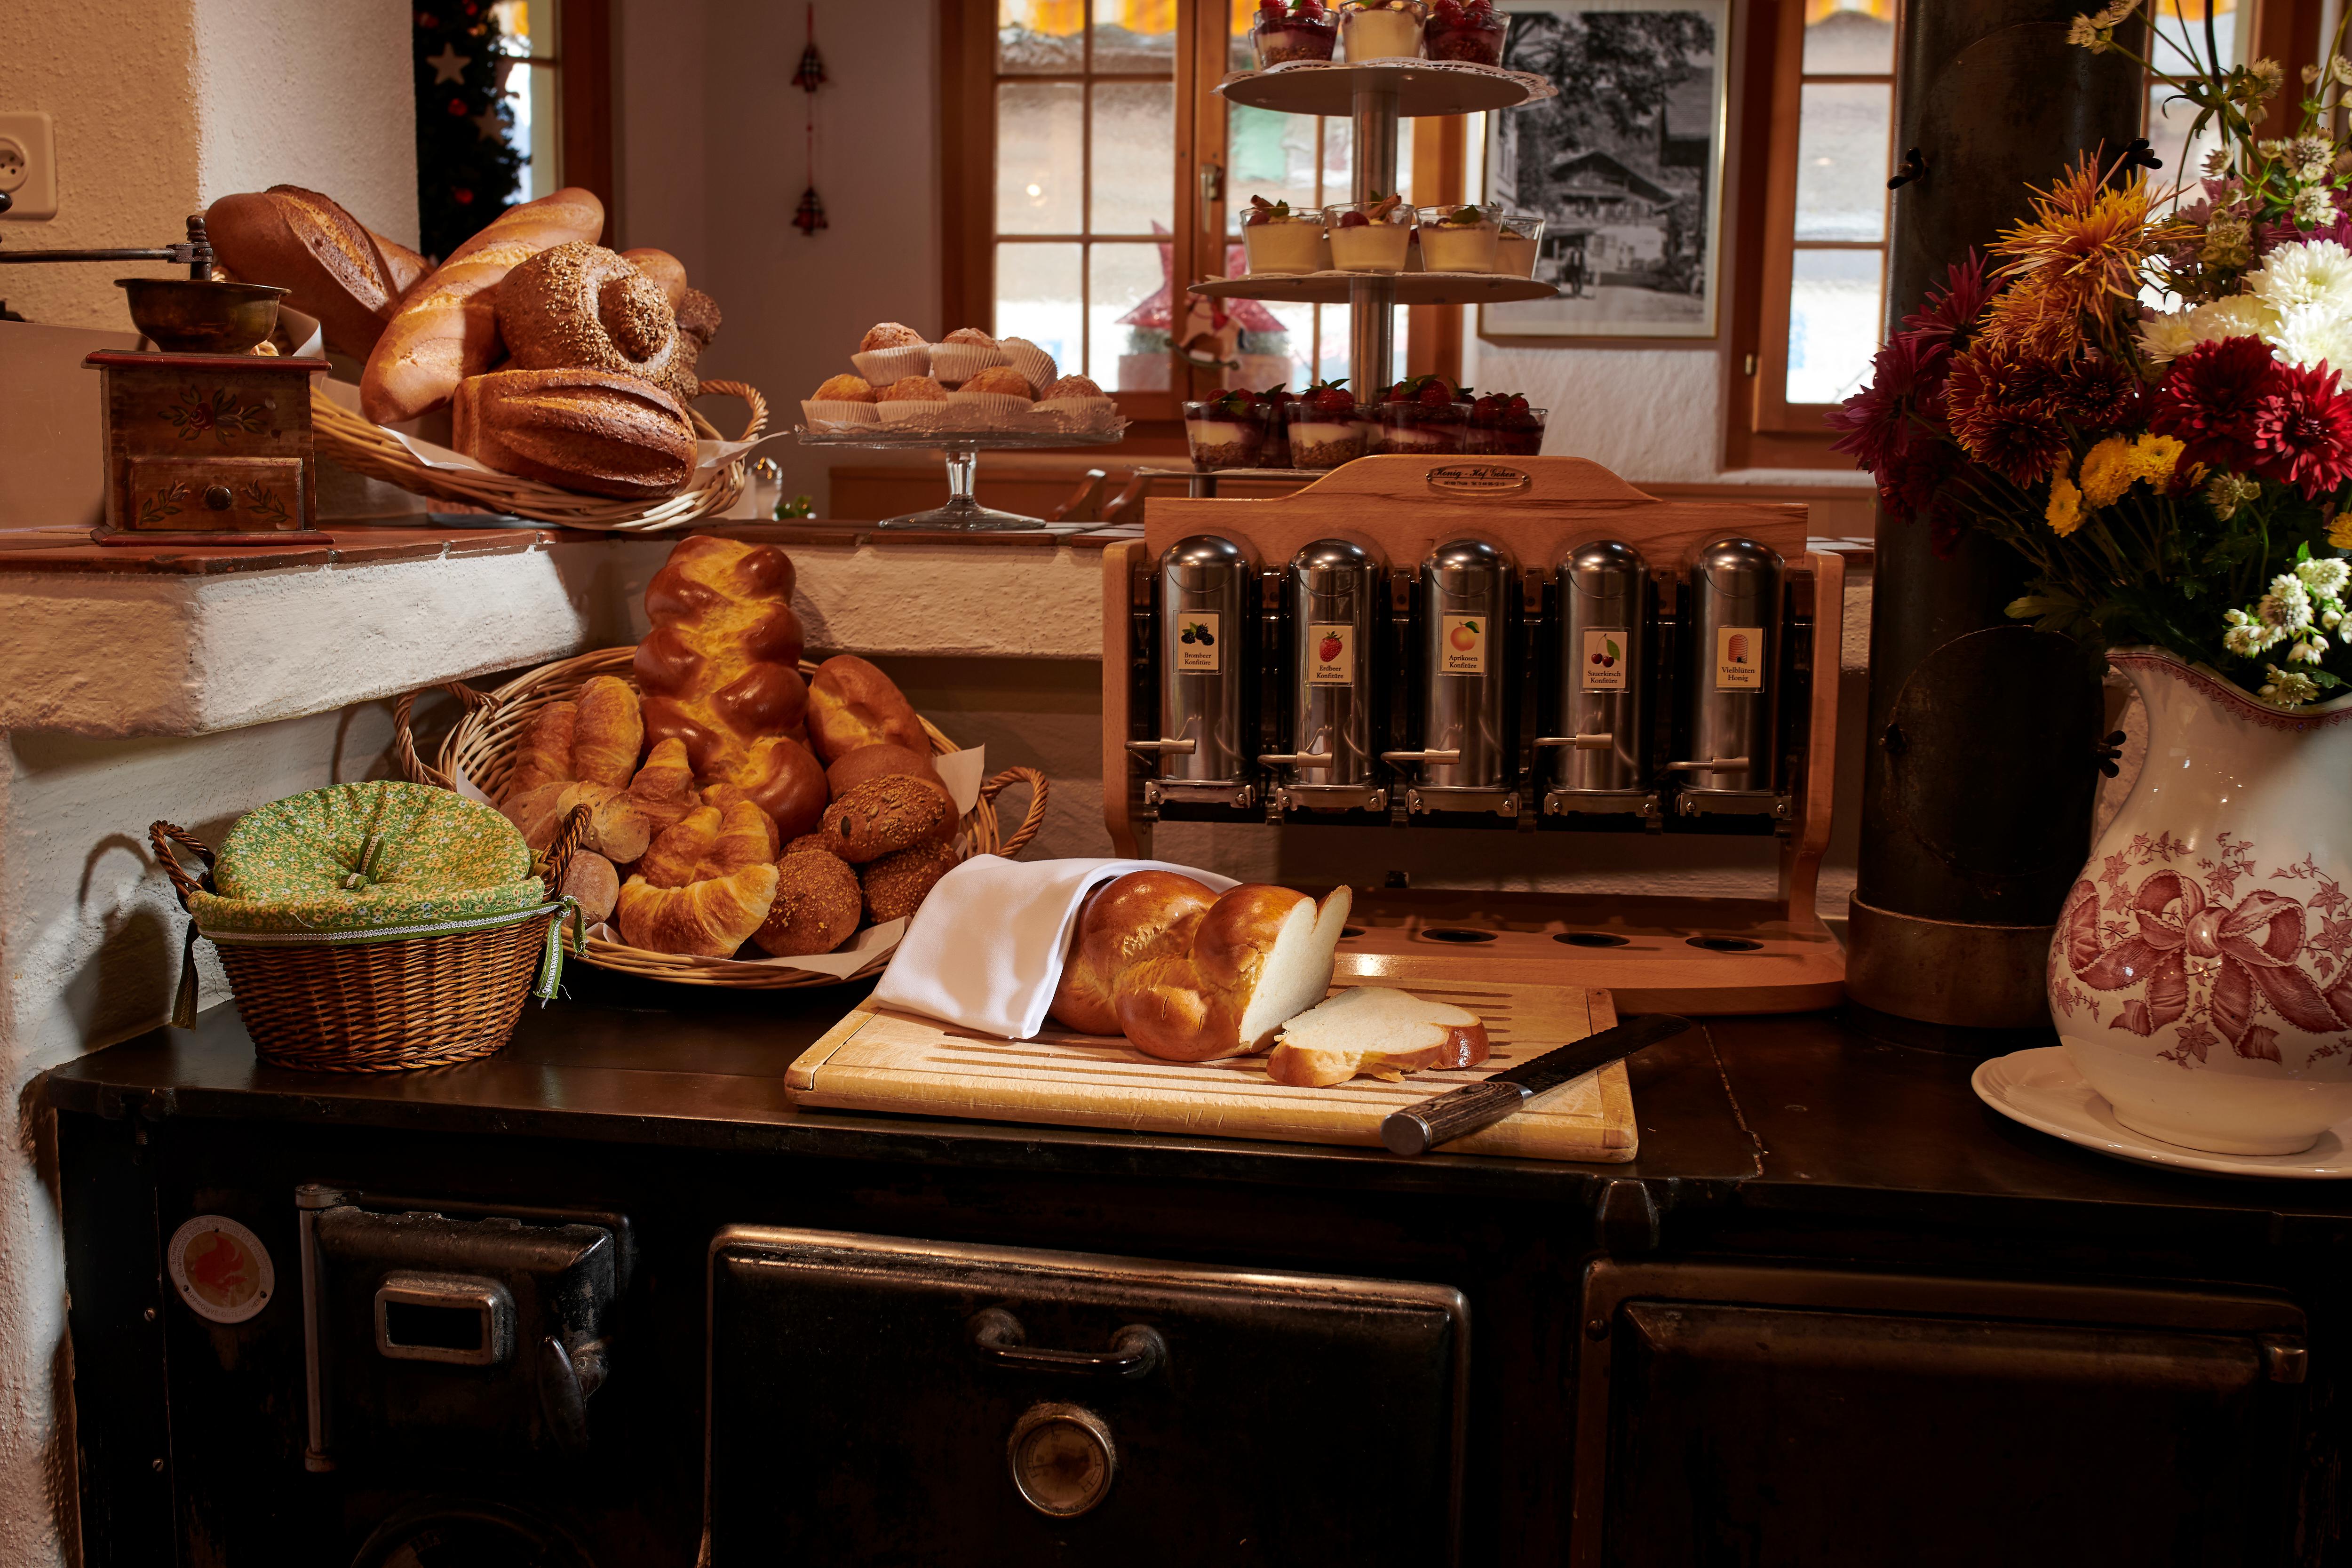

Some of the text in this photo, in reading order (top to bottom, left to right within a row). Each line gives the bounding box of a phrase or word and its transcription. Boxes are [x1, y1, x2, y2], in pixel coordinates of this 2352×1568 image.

[1434, 468, 1461, 479] Honig
[1470, 468, 1488, 480] Hof
[1490, 468, 1515, 478] Göken
[171, 1220, 202, 1265] SCHWEIZERISCHE
[177, 1235, 190, 1277] COMMISSION
[189, 1224, 210, 1237] SUISSE
